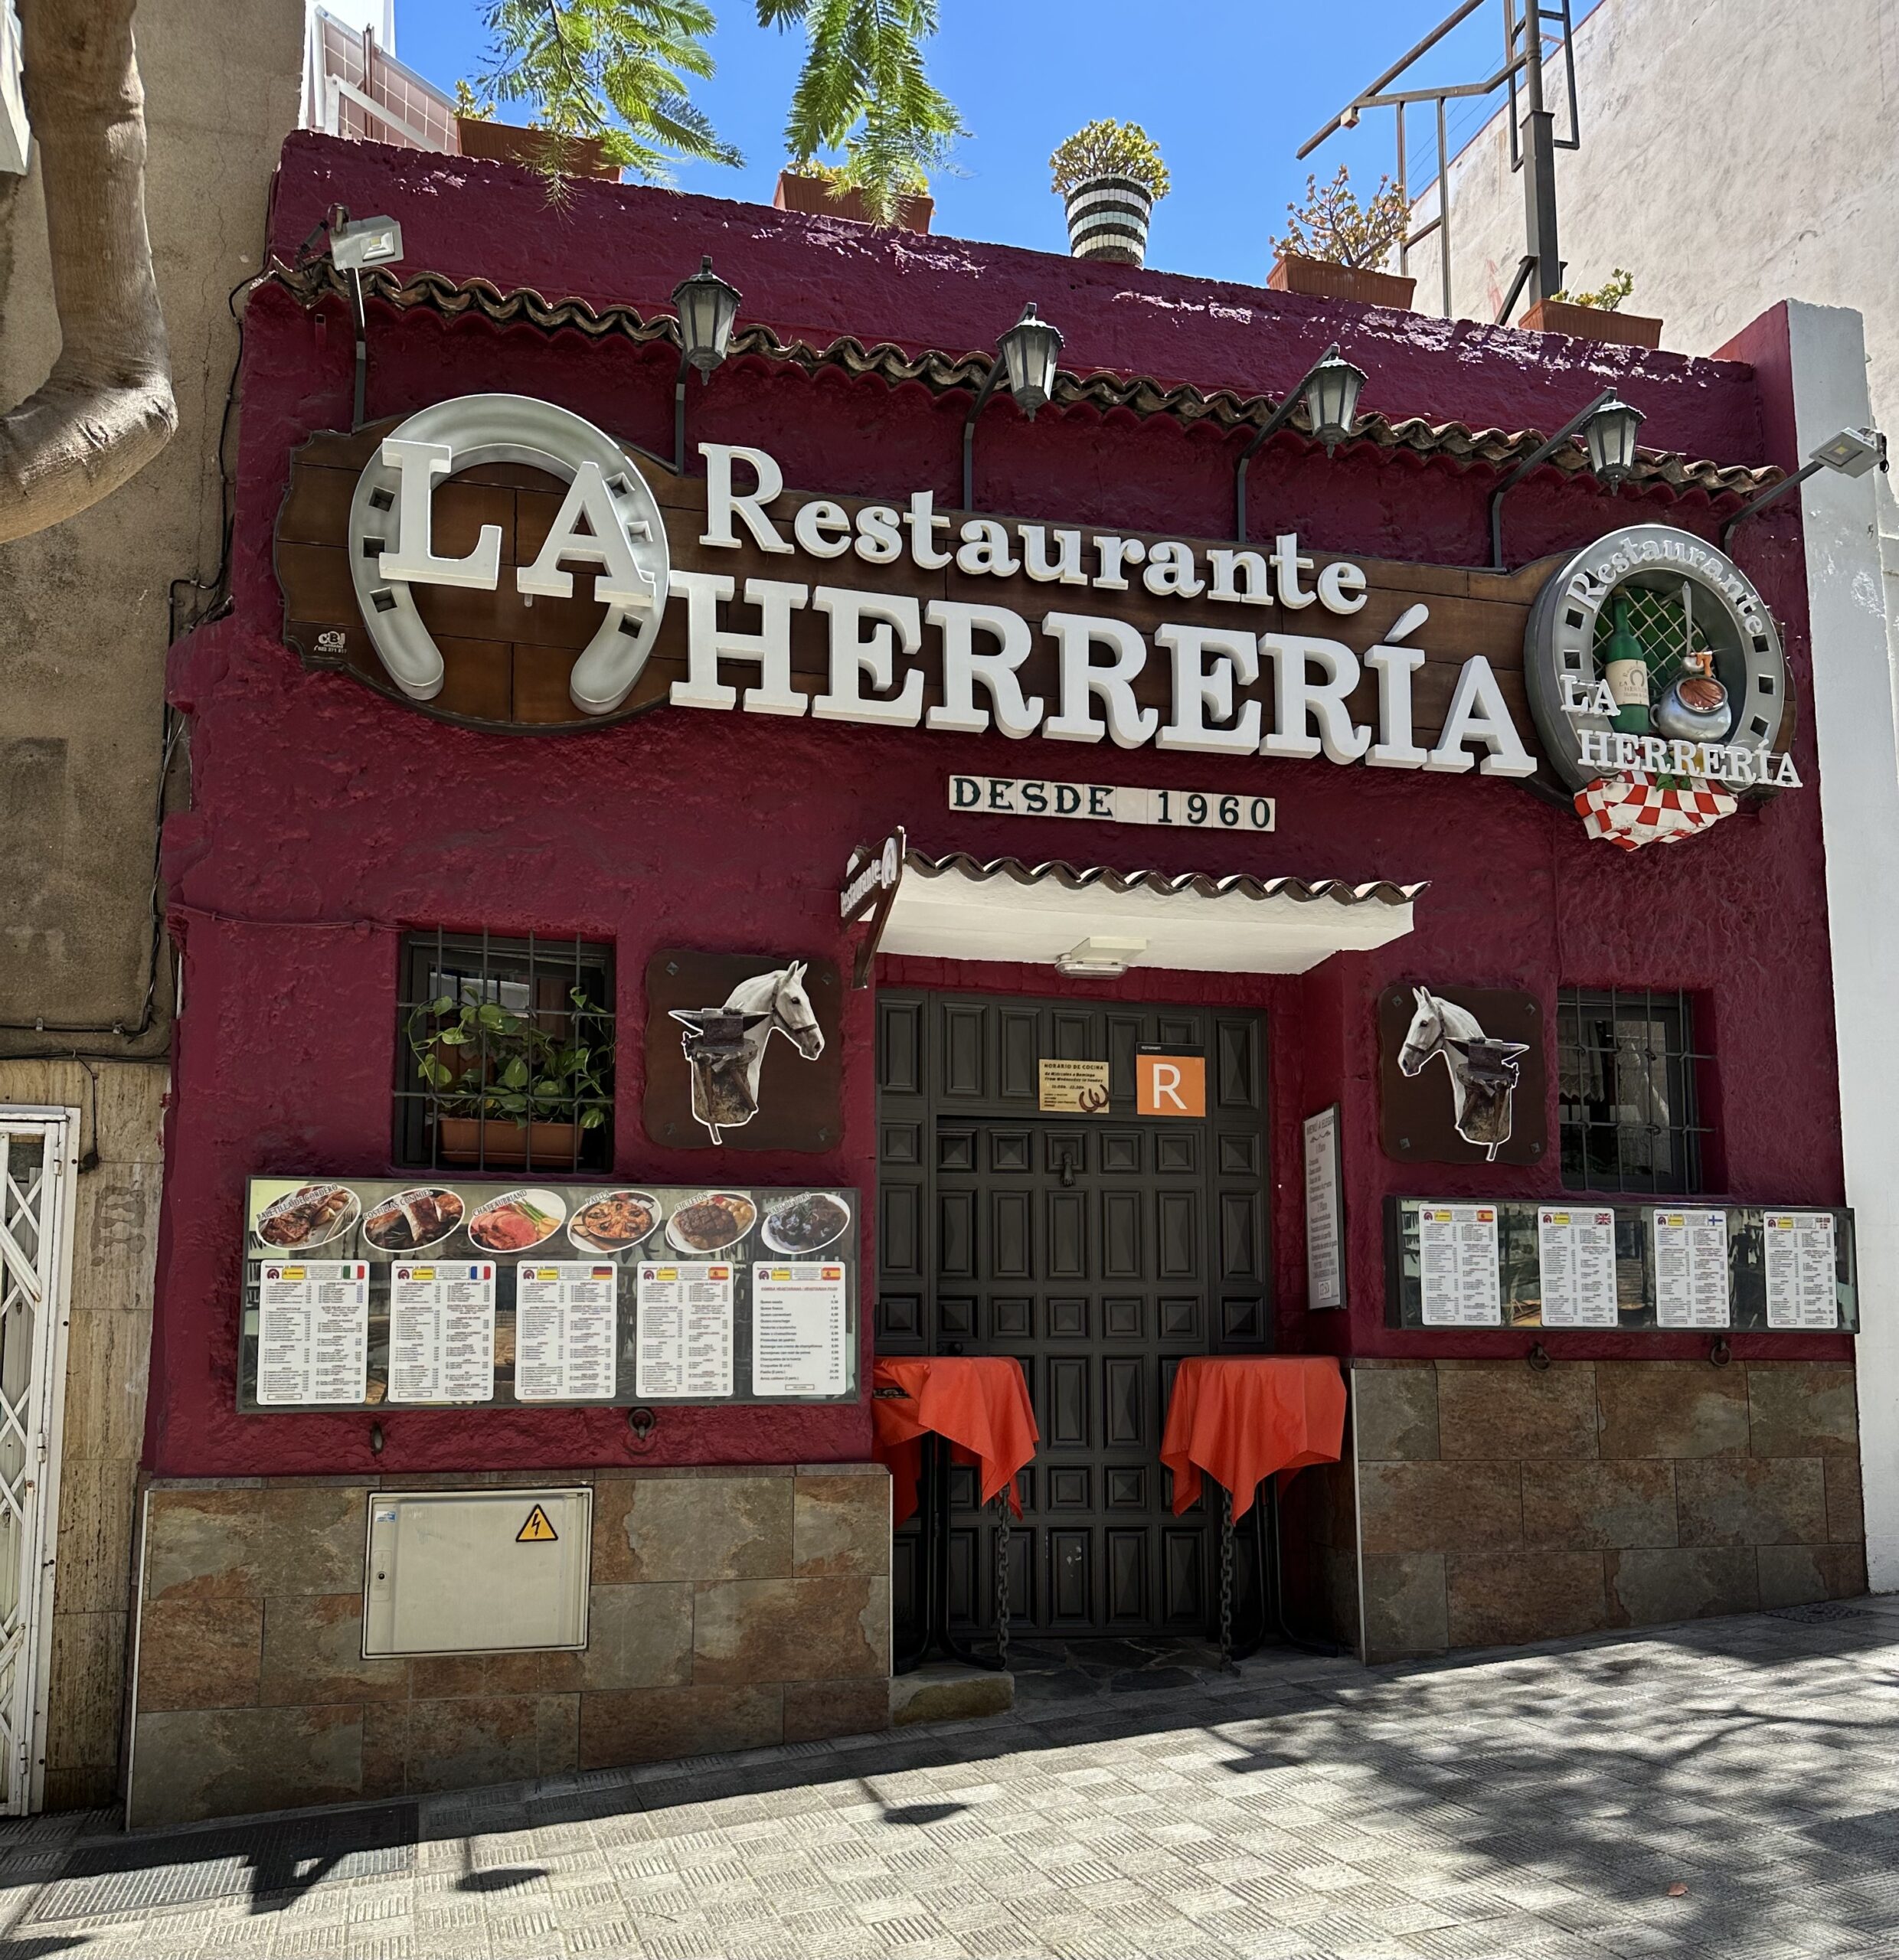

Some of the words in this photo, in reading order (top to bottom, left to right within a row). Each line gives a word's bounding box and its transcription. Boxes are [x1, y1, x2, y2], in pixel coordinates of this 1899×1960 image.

[698, 441, 1367, 615] Restaurante
[1565, 536, 1763, 636] Restaurante
[379, 438, 656, 607] LA
[668, 570, 1538, 778] HERRERÍA
[1560, 675, 1621, 716] LA
[1577, 728, 1803, 789] HERRERÍA
[953, 777, 1114, 818] DESDE
[1158, 791, 1271, 828] 1960
[1153, 1063, 1188, 1109] R
[256, 1201, 293, 1221] PALETILLA
[293, 1197, 304, 1206] DE
[304, 1184, 338, 1201] CORDERO
[362, 1201, 400, 1220] COSTILLAS
[400, 1195, 417, 1206] CON
[416, 1188, 433, 1200] MIEL
[472, 1189, 528, 1217] CHATEAUBRIAND
[586, 1190, 611, 1206] PAELLA
[767, 1204, 785, 1216] RABO
[784, 1200, 795, 1209] DE
[794, 1192, 811, 1205] TORO
